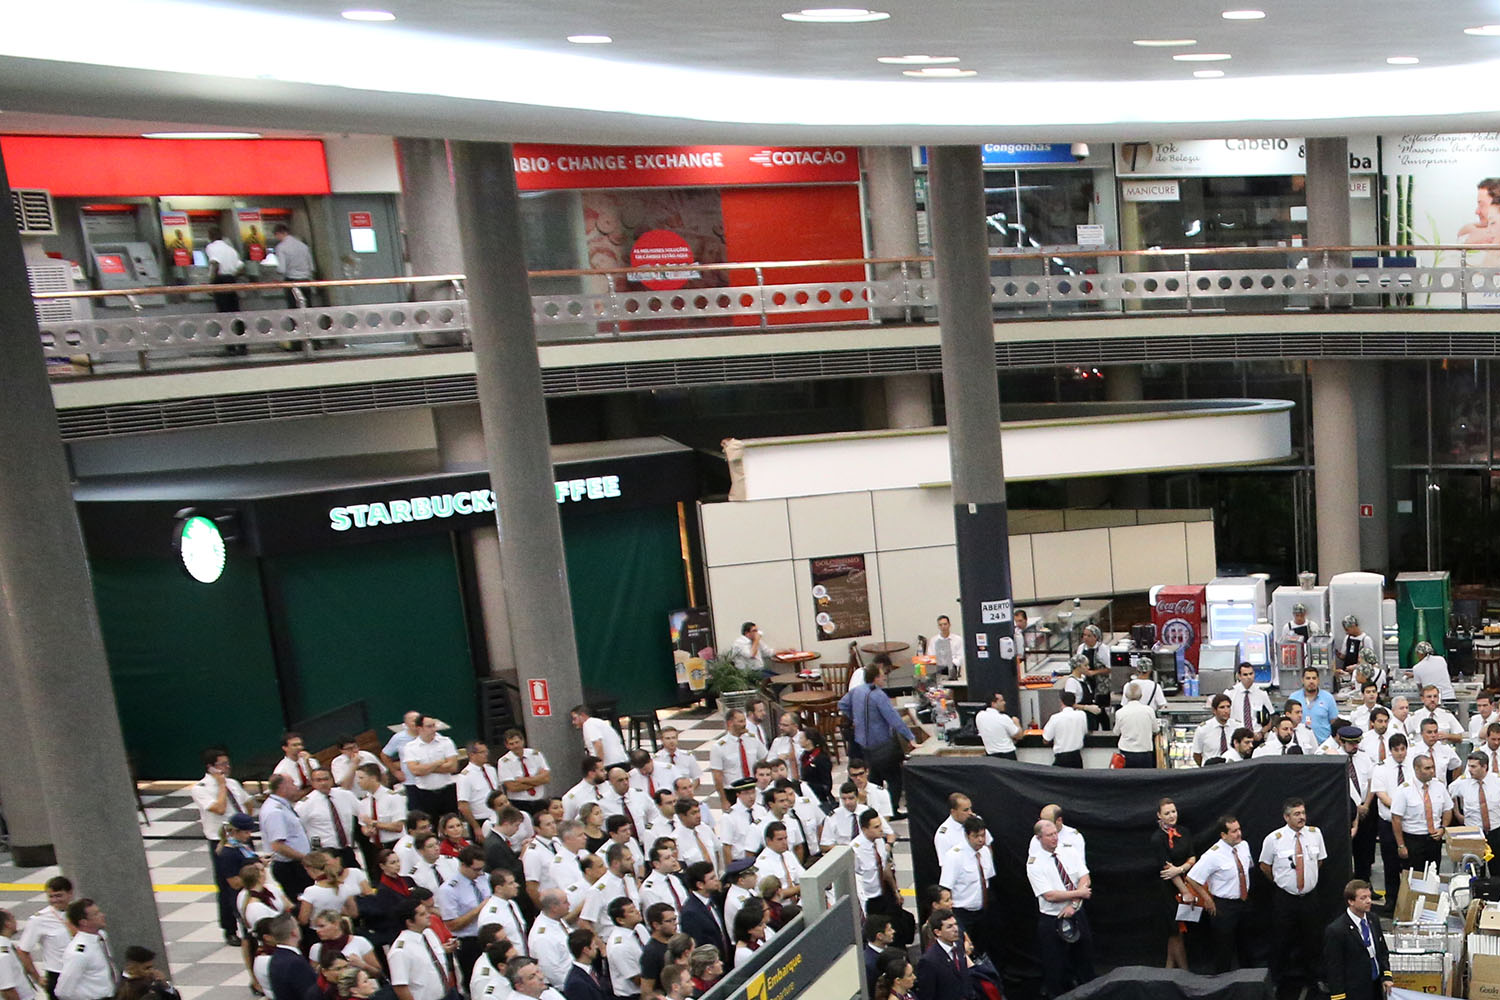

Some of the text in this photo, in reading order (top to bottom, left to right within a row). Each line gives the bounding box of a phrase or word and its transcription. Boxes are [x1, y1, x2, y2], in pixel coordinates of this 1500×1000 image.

[984, 144, 1051, 154] Congonhas
[1156, 143, 1177, 153] Tok
[1225, 139, 1288, 151] Cabelo
[557, 155, 627, 170] CHANGE
[635, 152, 724, 169] EXCHANGE
[771, 148, 846, 166] COTAÇÃO
[1126, 185, 1176, 196] MANICURE
[983, 602, 1009, 611] ABERTO
[767, 953, 802, 990] Embarque
